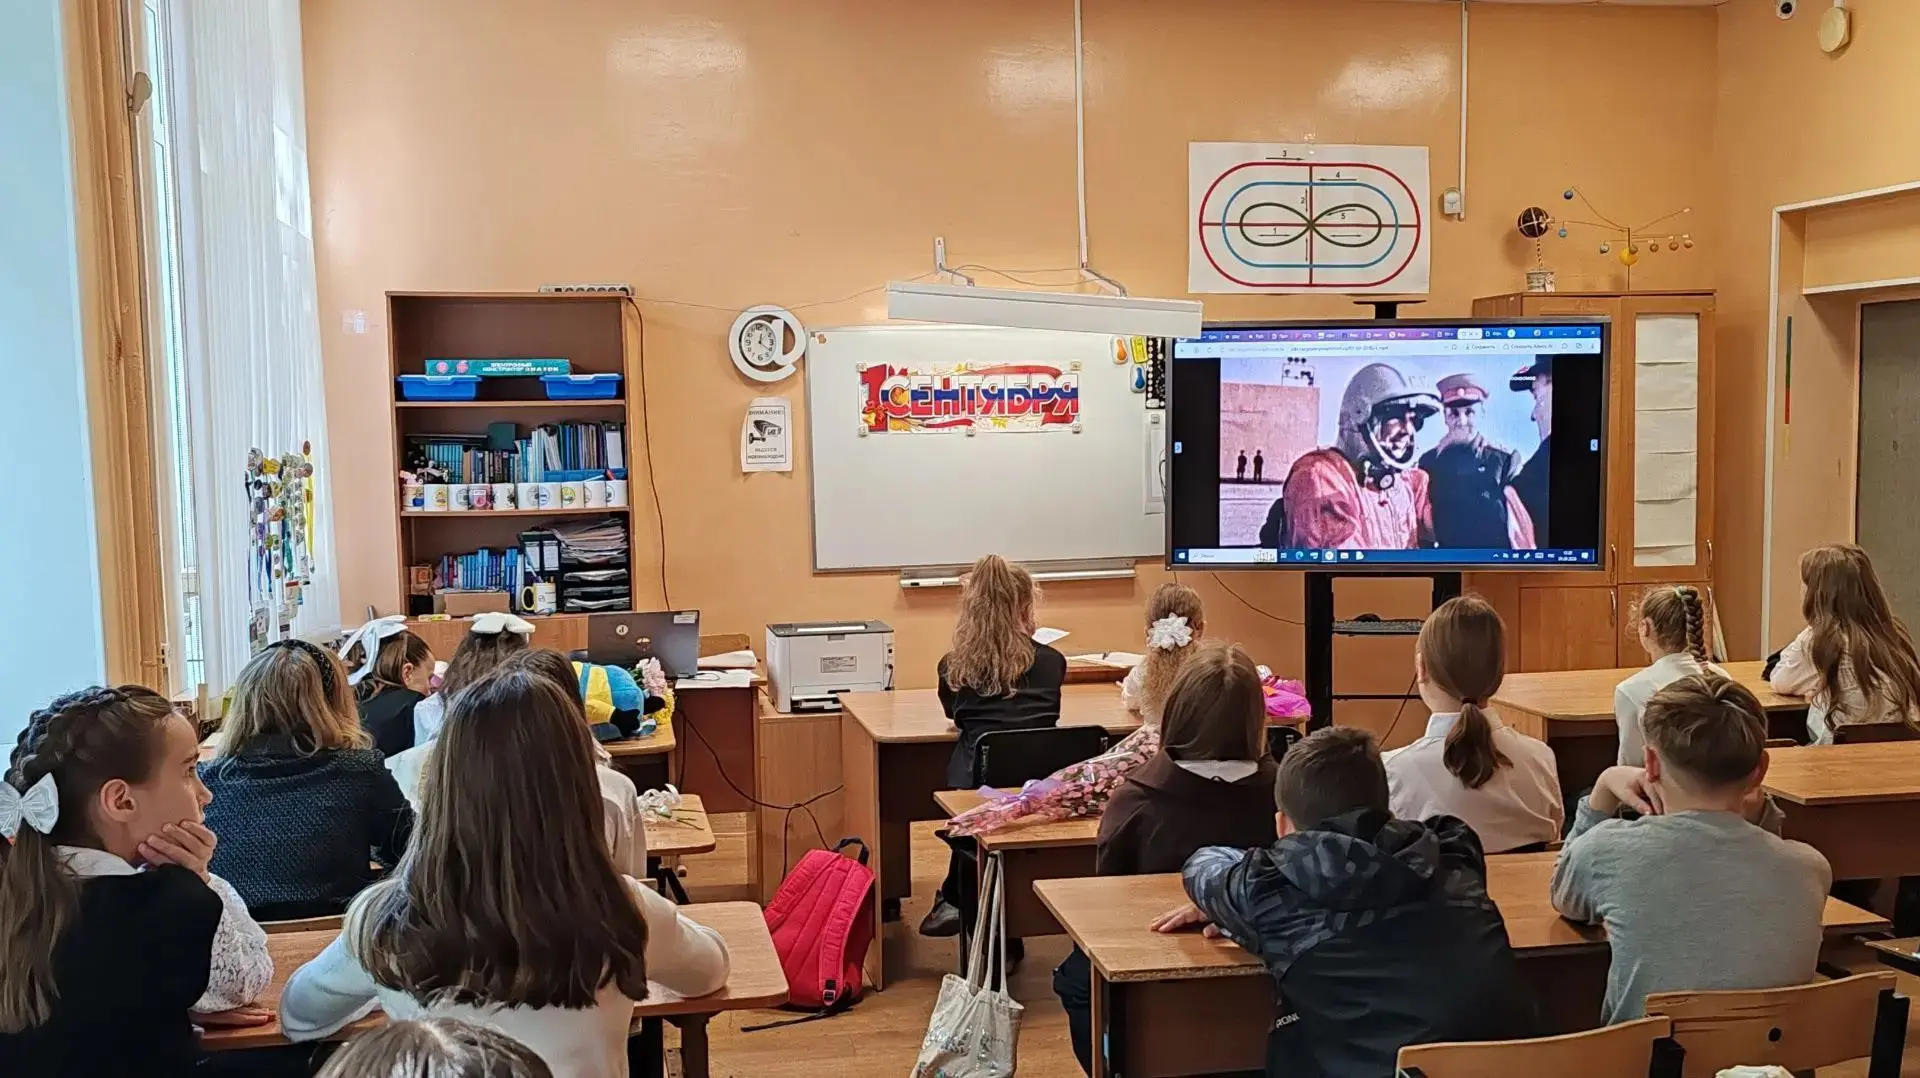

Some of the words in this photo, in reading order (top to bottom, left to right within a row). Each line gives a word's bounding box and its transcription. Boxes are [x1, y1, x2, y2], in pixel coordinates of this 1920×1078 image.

[1272, 227, 1277, 235] 1
[755, 323, 763, 331] 12
[861, 363, 890, 432] 1
[880, 372, 1080, 418] СЕНТЯБРЯ
